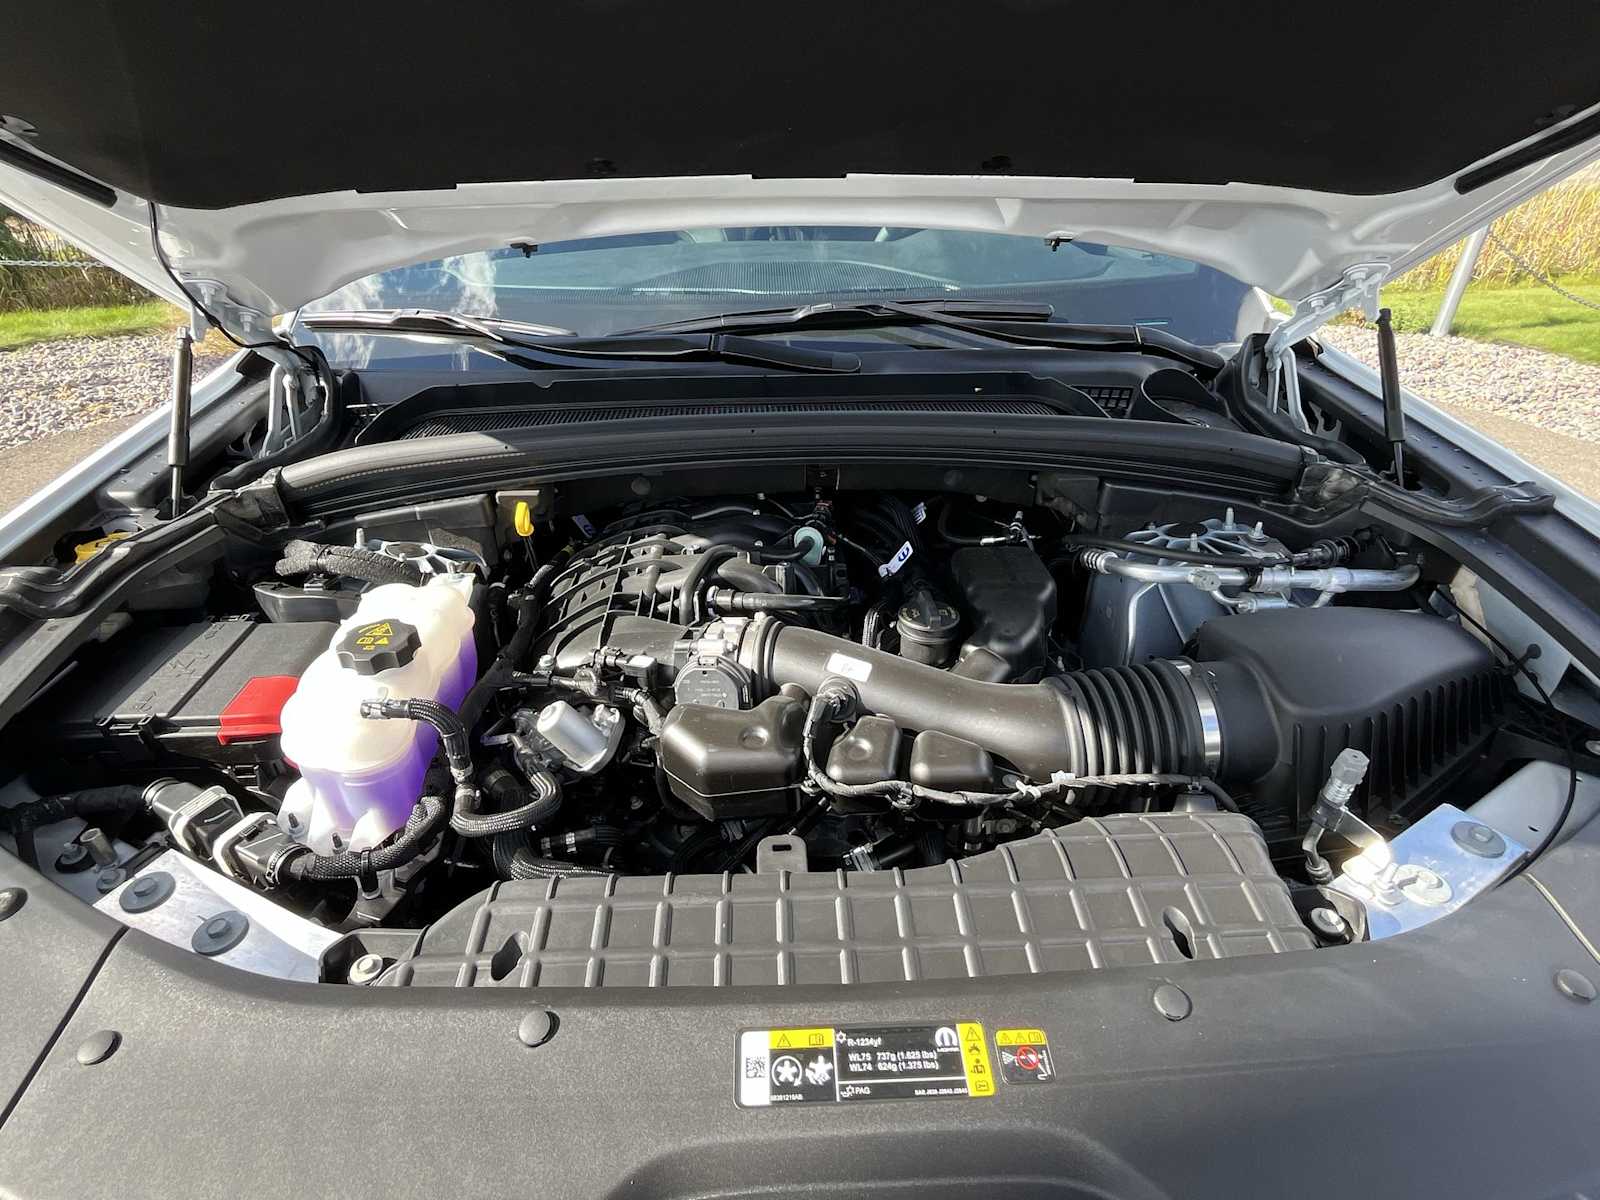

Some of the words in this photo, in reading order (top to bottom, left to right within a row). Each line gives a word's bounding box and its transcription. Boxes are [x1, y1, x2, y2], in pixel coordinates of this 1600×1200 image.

[847, 1037, 882, 1047] R-1234yf
[848, 1053, 872, 1062] WL75
[877, 1051, 896, 1061] 737g
[922, 1050, 938, 1060] lbs)
[849, 1063, 872, 1071] WL74
[878, 1062, 898, 1072] 624g
[923, 1061, 939, 1070] lbs)
[855, 1086, 871, 1095] PAG
